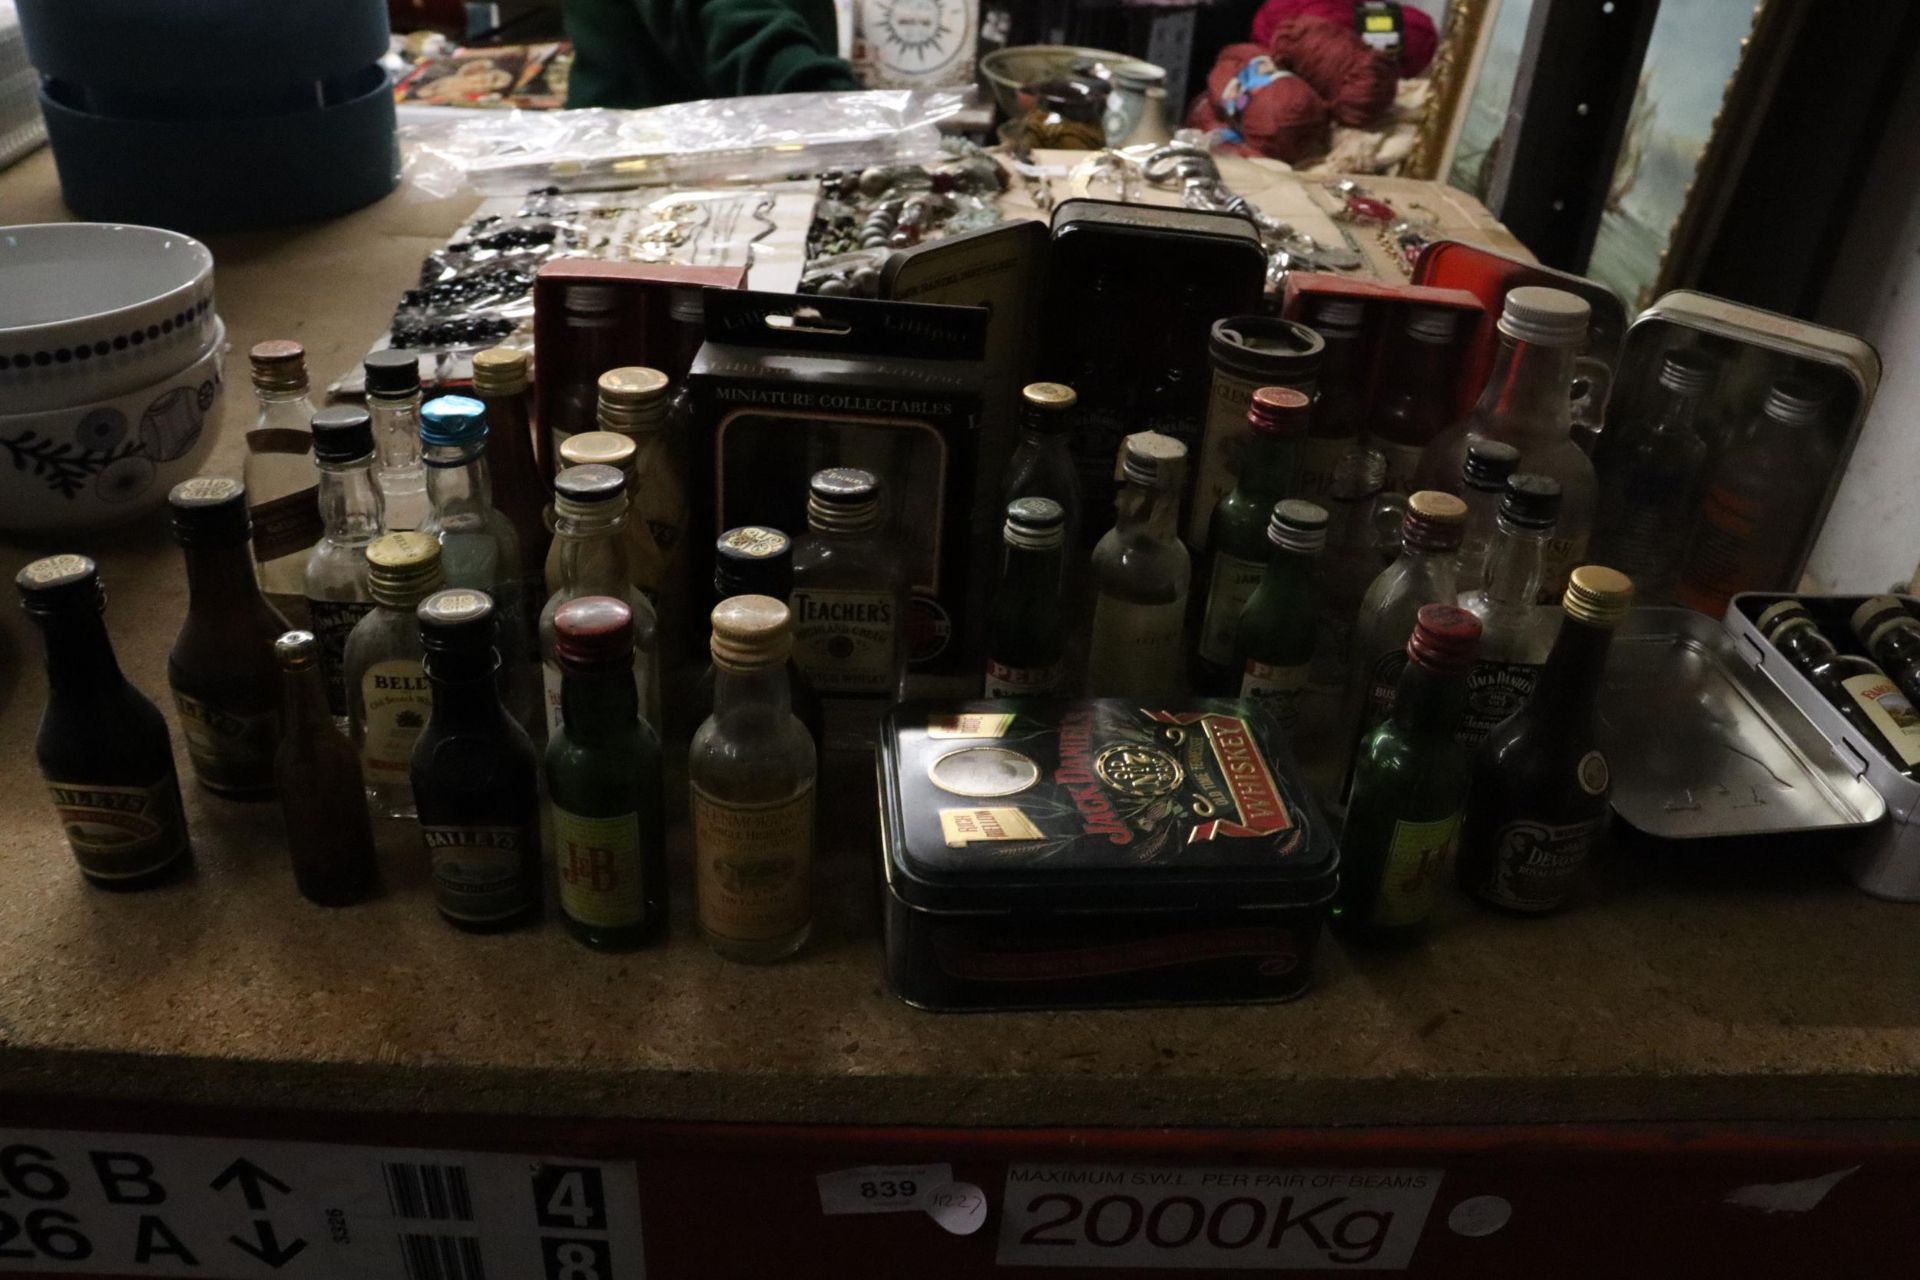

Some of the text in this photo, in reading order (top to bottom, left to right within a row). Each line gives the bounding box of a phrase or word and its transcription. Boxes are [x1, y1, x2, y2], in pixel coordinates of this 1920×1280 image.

[715, 386, 952, 416] MINIATURE COLLECTABLES
[794, 594, 891, 623] TEACHER'S
[1213, 724, 1277, 820] WHISKEY
[953, 815, 978, 833] RICH
[1067, 784, 1134, 845] JACK
[0, 1145, 167, 1205] 6 B
[860, 1180, 918, 1199] 839
[1009, 1169, 1125, 1185] MAXIMUM
[1201, 1173, 1249, 1188] PER
[1254, 1174, 1305, 1188] PAIR
[1311, 1174, 1347, 1188] OF
[1348, 1174, 1428, 1189] BEAMS
[547, 1171, 595, 1228] 4
[135, 1214, 199, 1265] A
[1019, 1192, 1396, 1264] 2000Kg
[556, 1244, 602, 1280] 8
